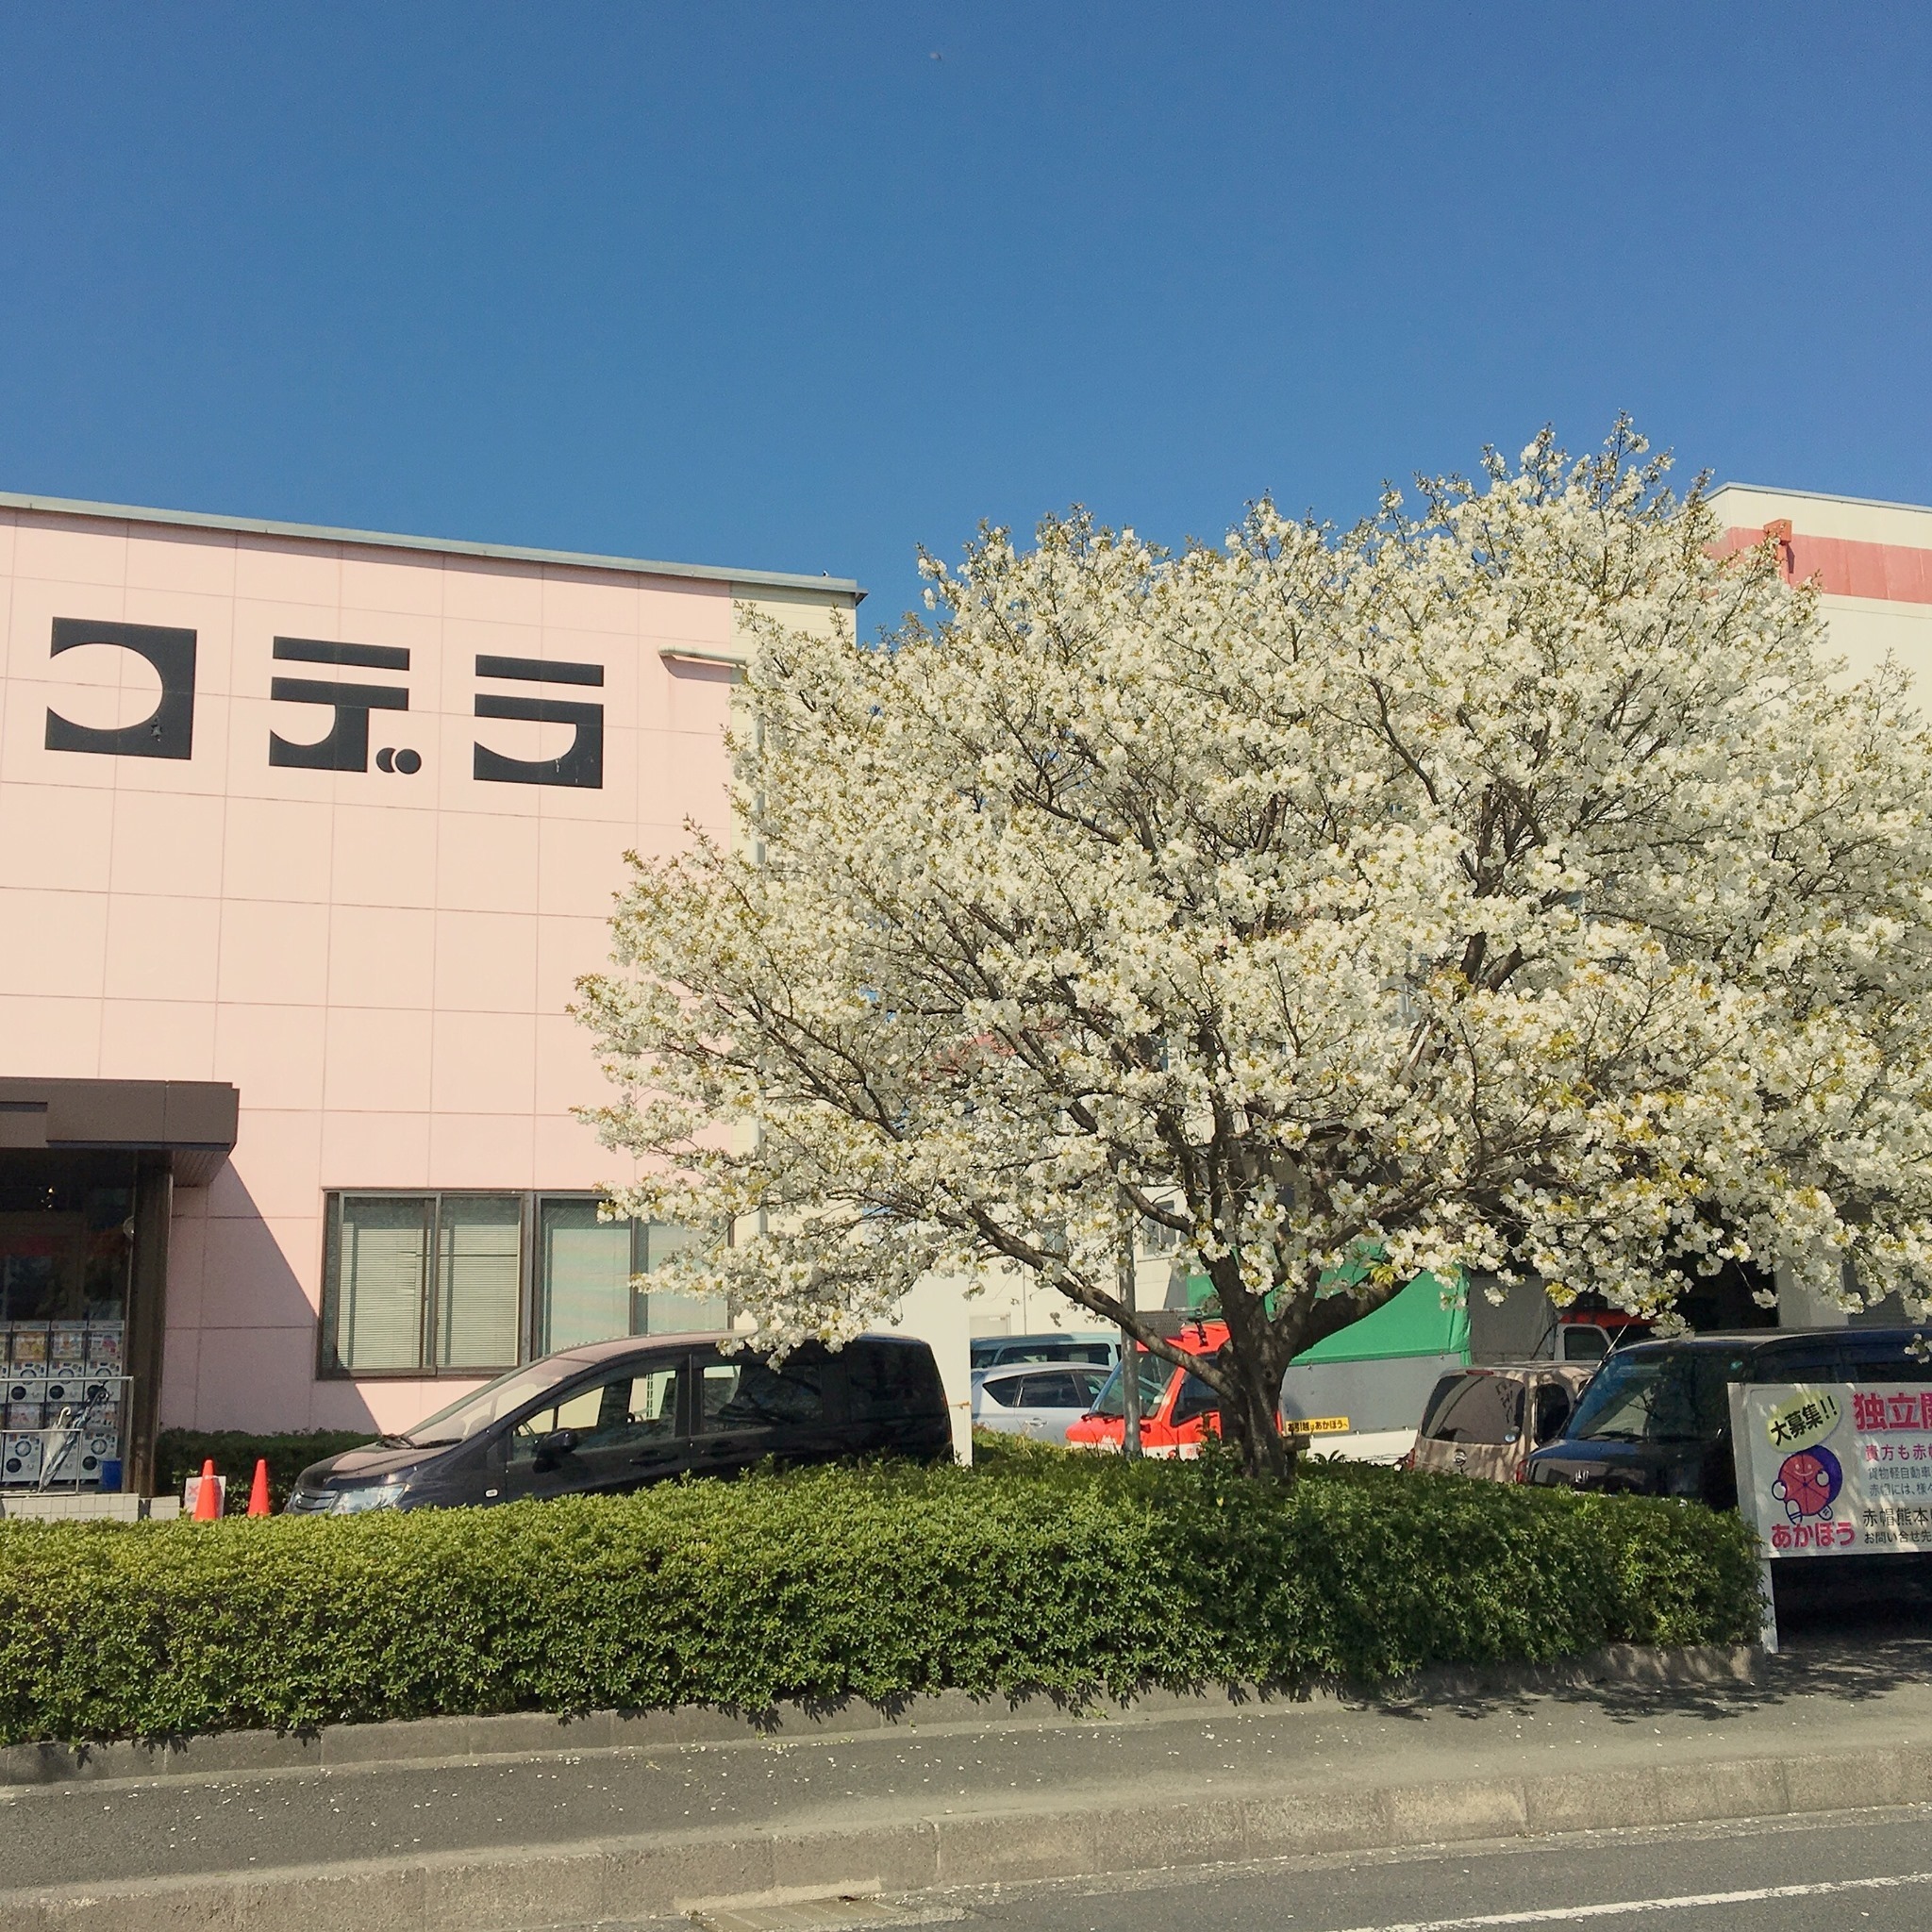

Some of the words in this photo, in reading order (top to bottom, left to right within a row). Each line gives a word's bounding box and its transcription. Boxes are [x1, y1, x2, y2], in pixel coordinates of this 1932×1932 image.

[45, 617, 604, 789] コデラ
[1868, 1466, 1932, 1480] 貨物軽自動車
[1862, 1507, 1932, 1527] 赤帽熊本
[1772, 1522, 1856, 1549] あかぼう
